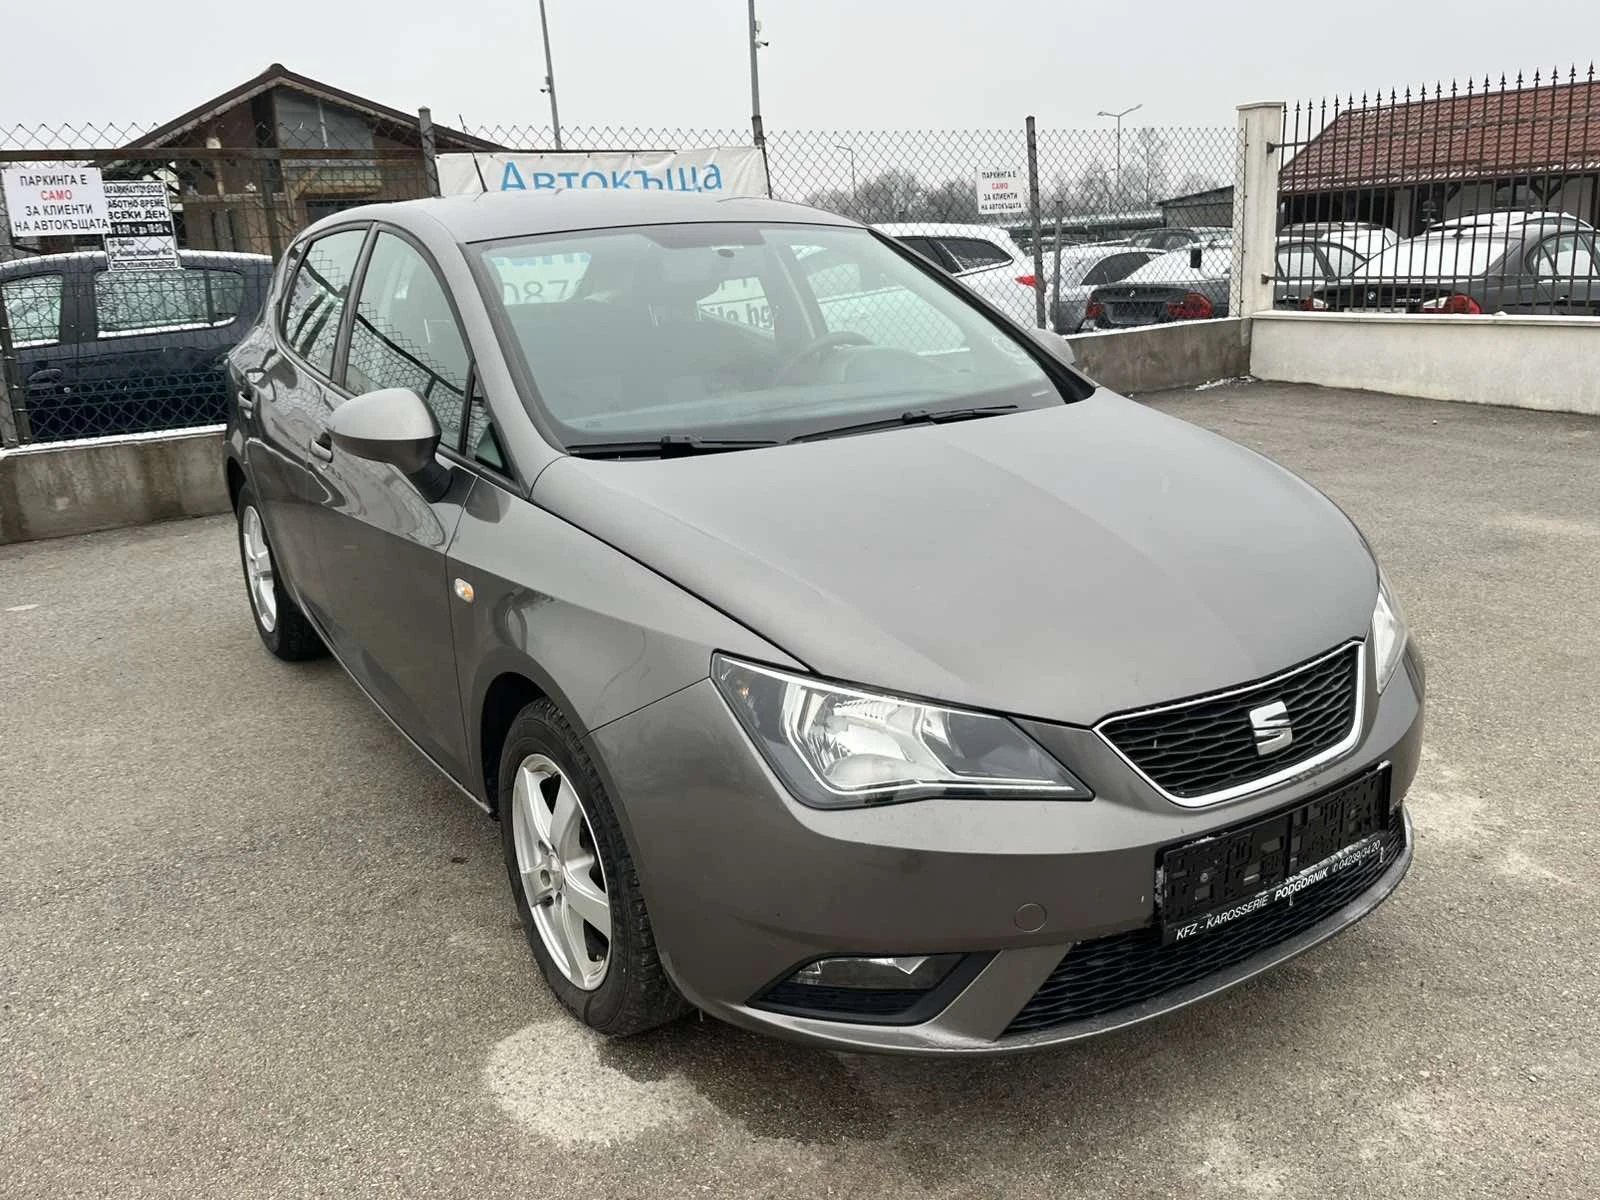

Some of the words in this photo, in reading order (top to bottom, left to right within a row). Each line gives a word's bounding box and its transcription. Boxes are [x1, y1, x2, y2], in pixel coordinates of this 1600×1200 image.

[20, 174, 77, 186] ПАРКИНГА
[80, 174, 88, 185] Е
[40, 189, 73, 201] САМО
[26, 205, 41, 216] ЗА
[43, 203, 93, 216] КЛИЕНТИ
[107, 199, 138, 209] АБОТНО
[15, 220, 30, 232] НА
[34, 218, 109, 231] АВТОКЪЩАТА
[1176, 921, 1198, 941] KFZ
[1206, 894, 1269, 929] KAROSSERIE
[1274, 866, 1329, 902] PODGORNIK
